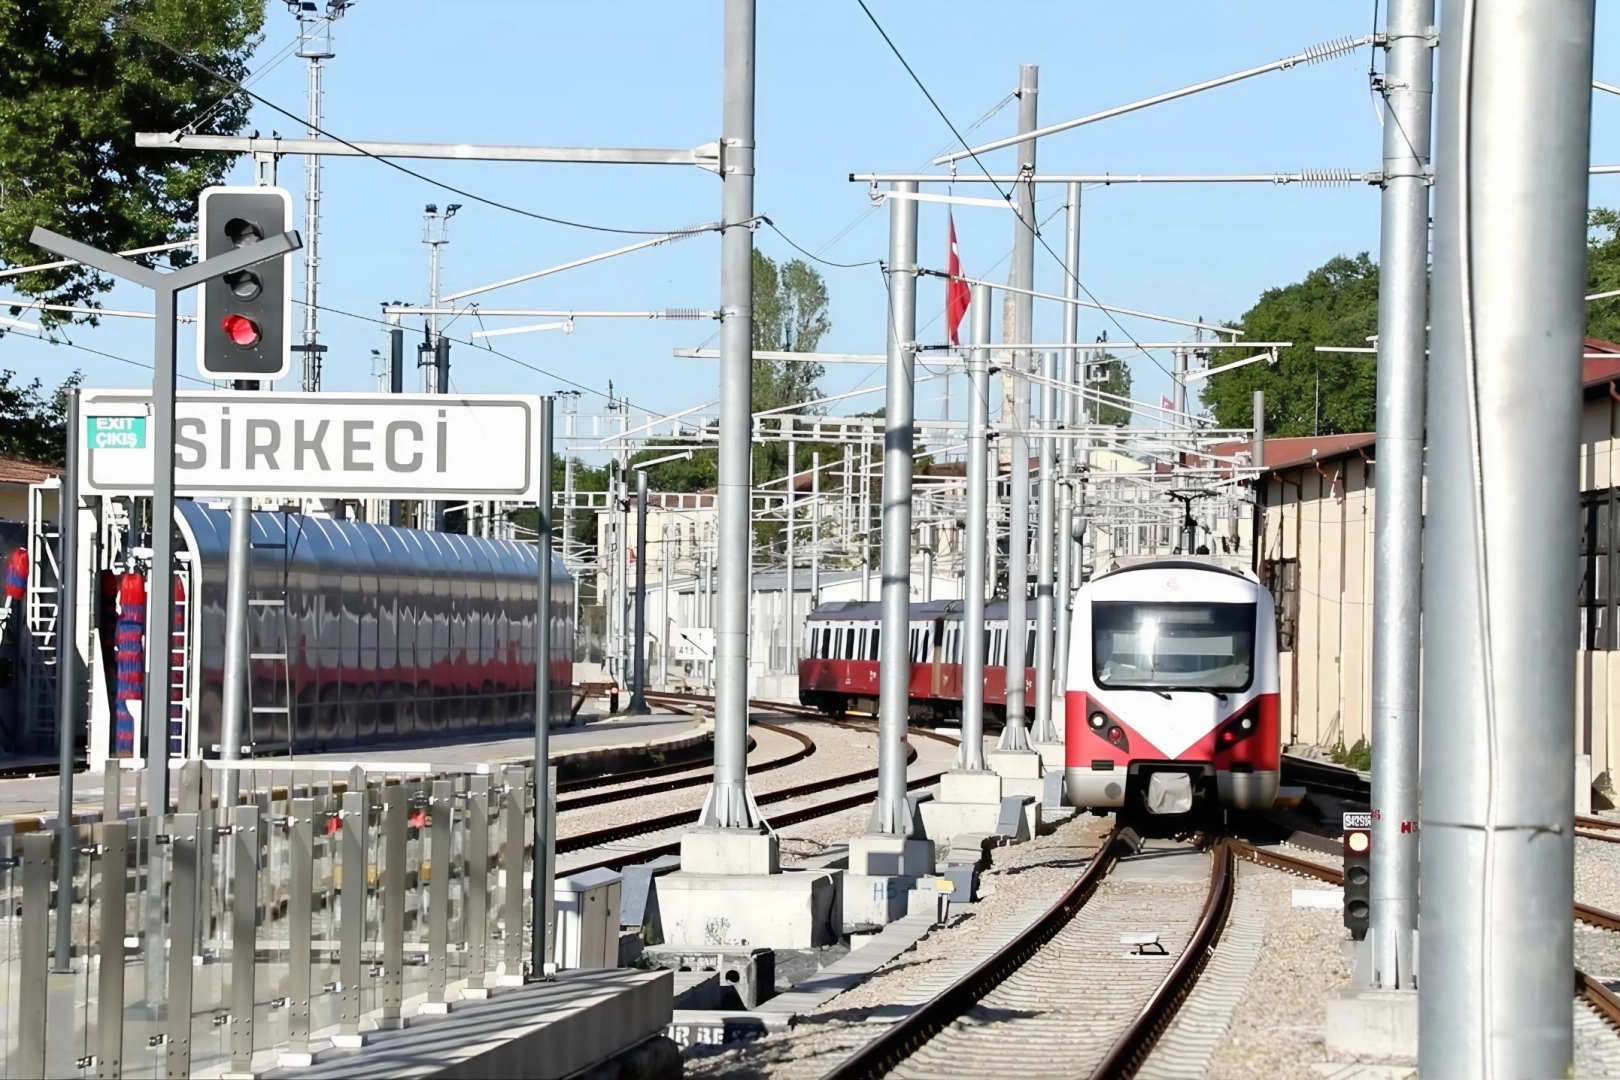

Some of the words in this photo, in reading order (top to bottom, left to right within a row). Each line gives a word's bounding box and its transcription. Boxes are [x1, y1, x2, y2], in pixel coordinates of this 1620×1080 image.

[96, 417, 136, 430] EXIT
[95, 432, 138, 448] ÇIKIŞ
[174, 406, 447, 473] SİRKECİ
